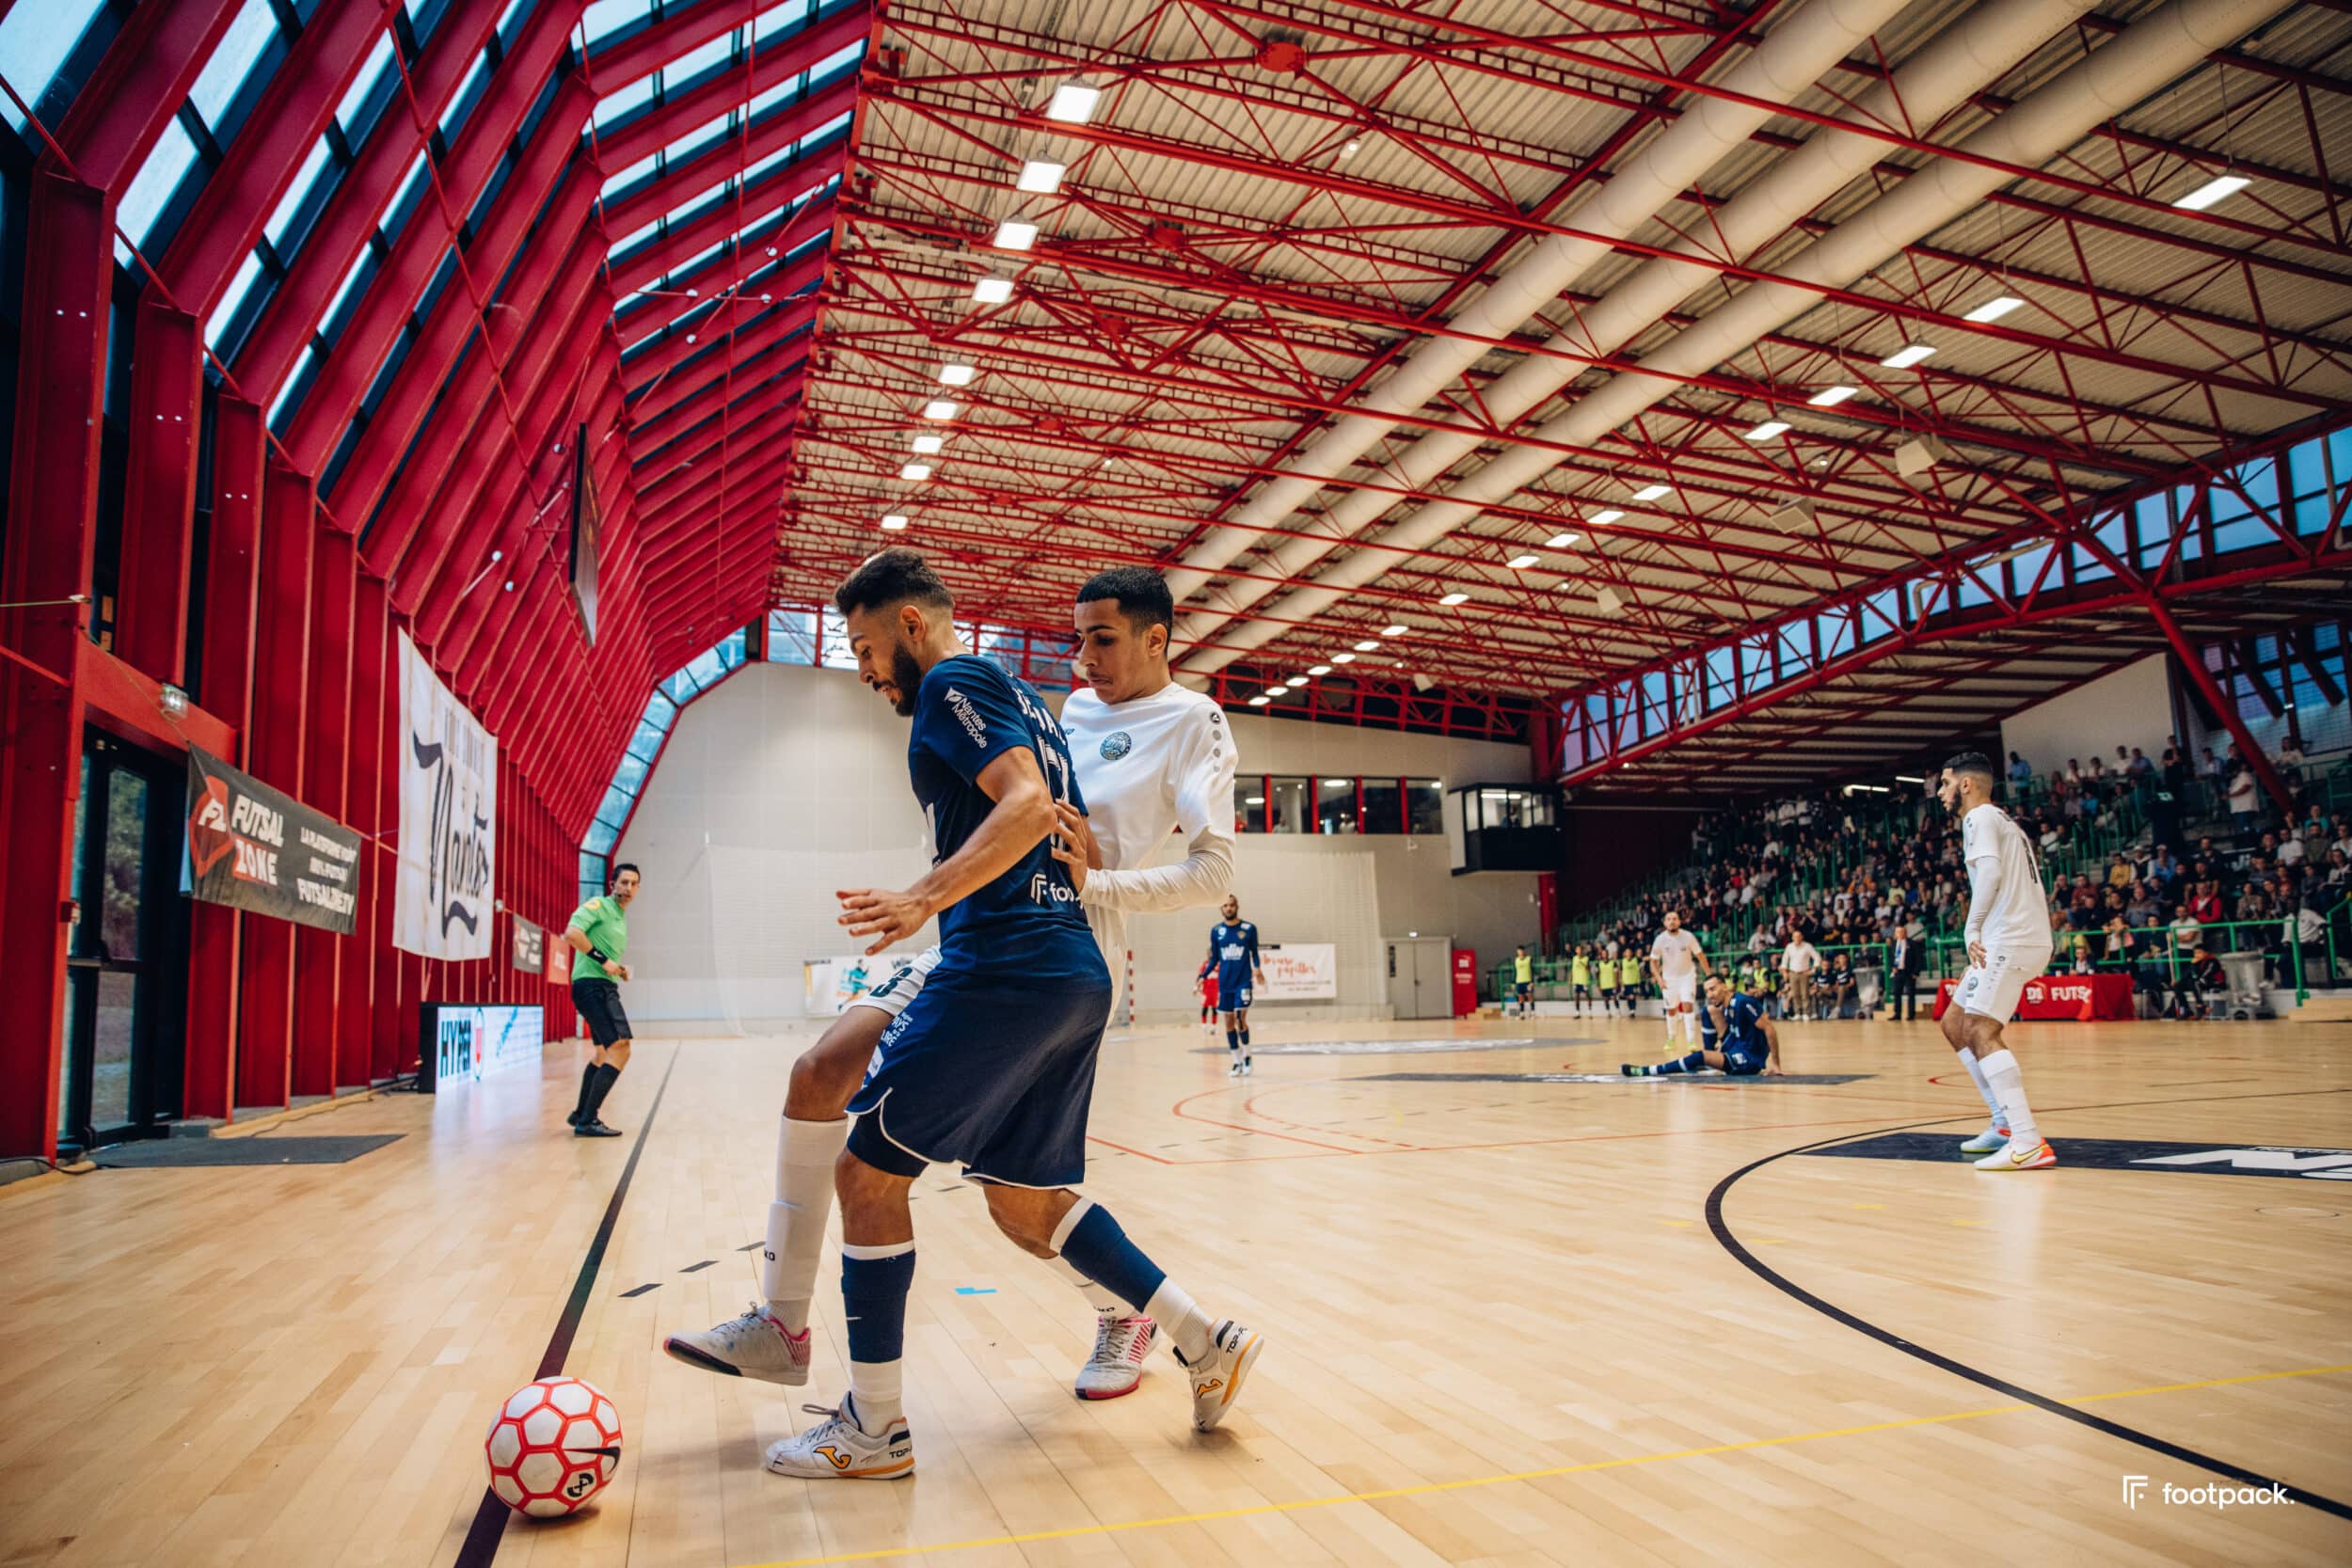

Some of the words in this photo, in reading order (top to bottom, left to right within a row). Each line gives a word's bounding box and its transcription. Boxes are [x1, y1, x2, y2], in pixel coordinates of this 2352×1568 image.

[951, 702, 988, 749] Métropole
[960, 697, 987, 731] Nantes
[231, 794, 284, 847] FUTSAL
[235, 839, 278, 886] ZONE
